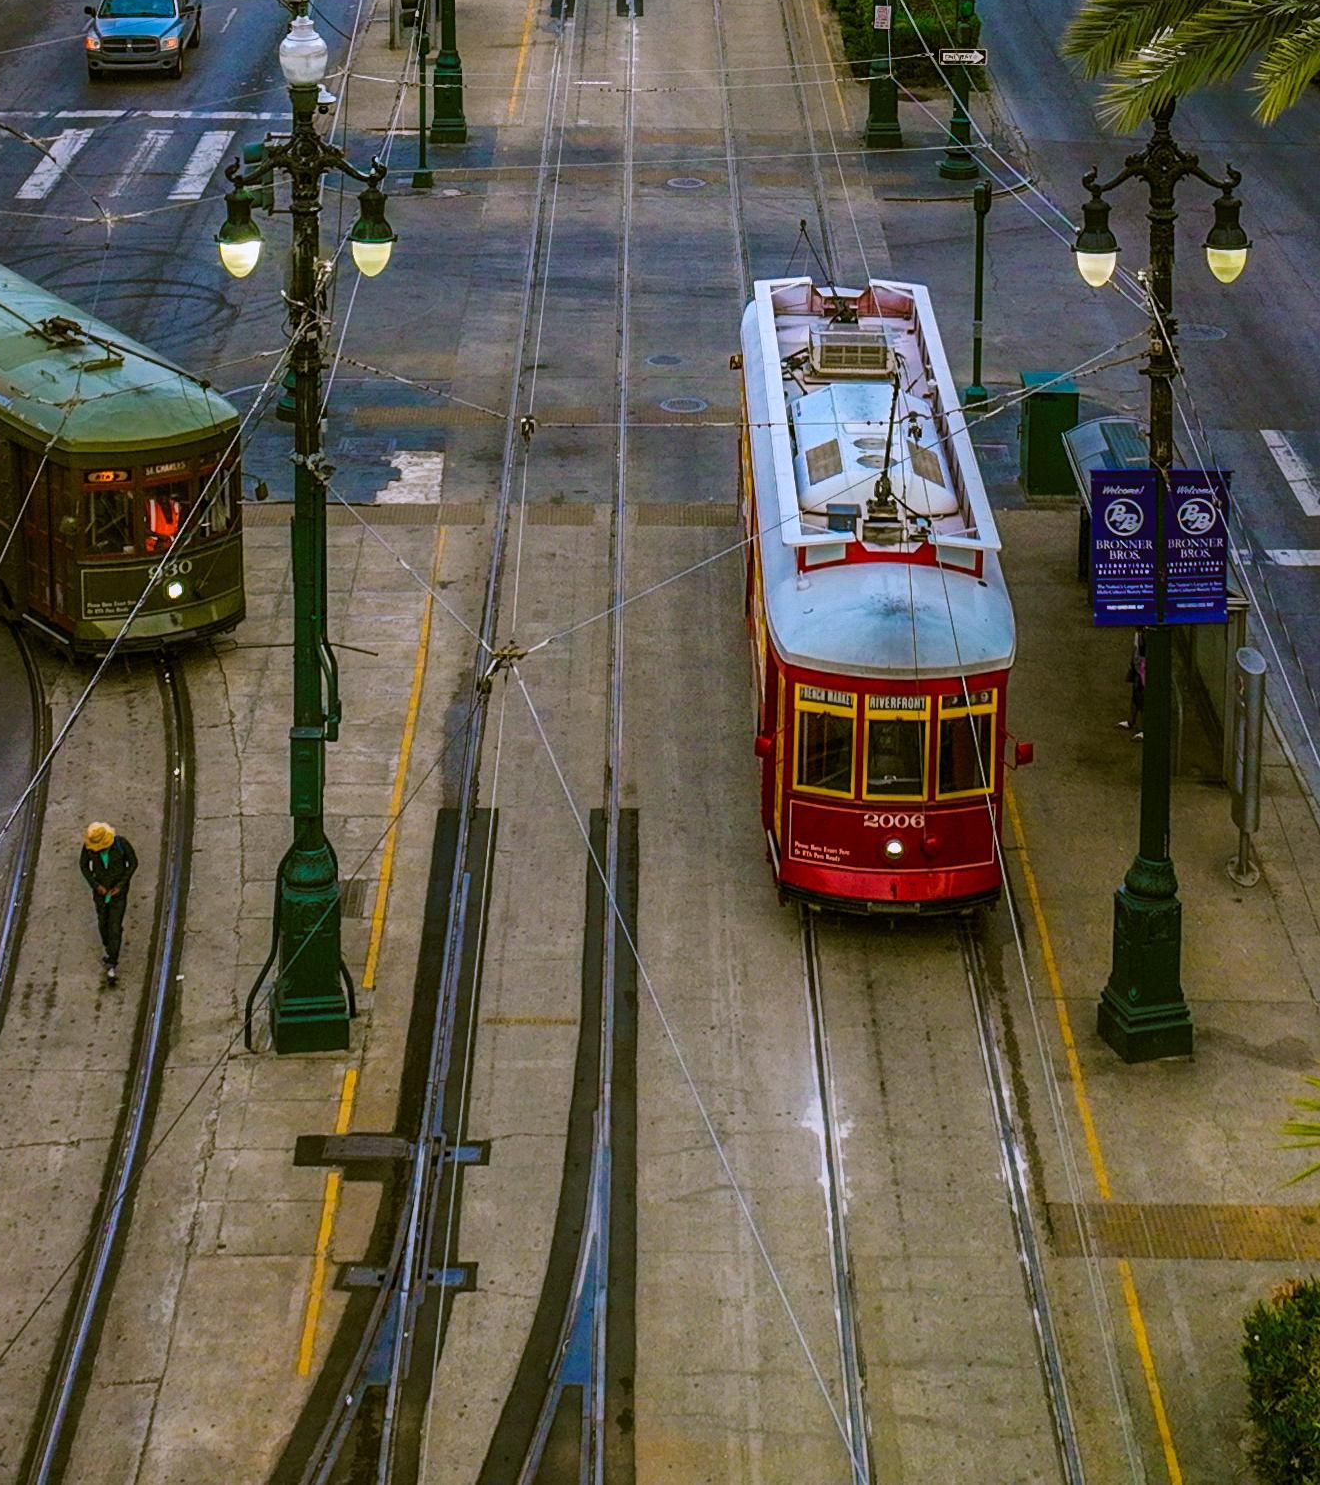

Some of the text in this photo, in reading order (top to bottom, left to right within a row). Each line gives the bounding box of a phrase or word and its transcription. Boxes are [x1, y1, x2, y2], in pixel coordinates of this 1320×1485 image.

[1102, 485, 1145, 495] Welcome!
[1096, 539, 1153, 549] BRONNER
[1168, 538, 1224, 548] BRONNER
[148, 560, 192, 580] 930
[869, 695, 926, 710] RIVERFRONT
[863, 813, 925, 828] 2006
